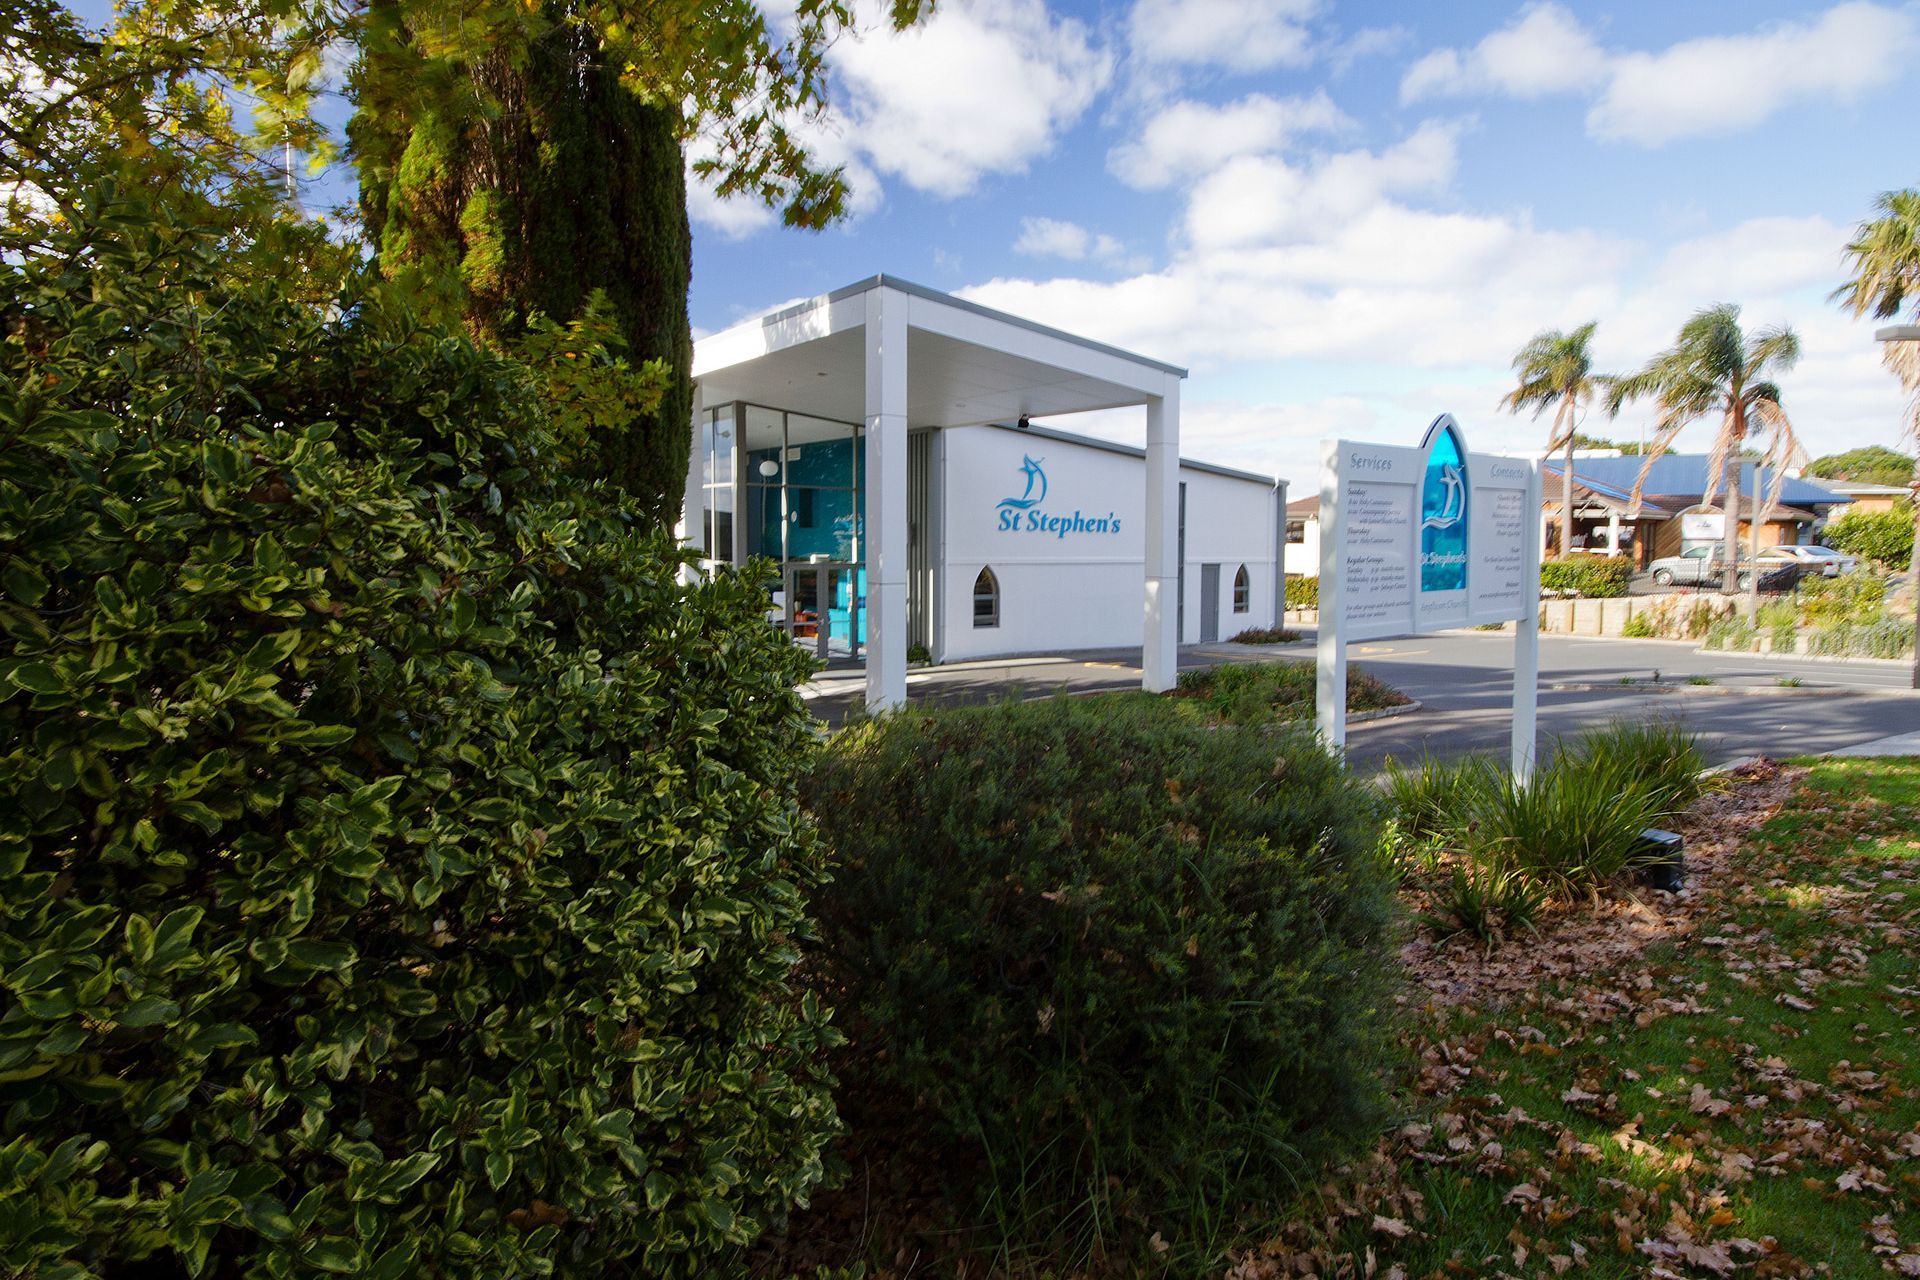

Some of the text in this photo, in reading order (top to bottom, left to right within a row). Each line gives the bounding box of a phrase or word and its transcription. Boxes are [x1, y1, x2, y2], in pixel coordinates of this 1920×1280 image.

[1350, 453, 1393, 471] Services
[998, 508, 1121, 539] St Stephen's
